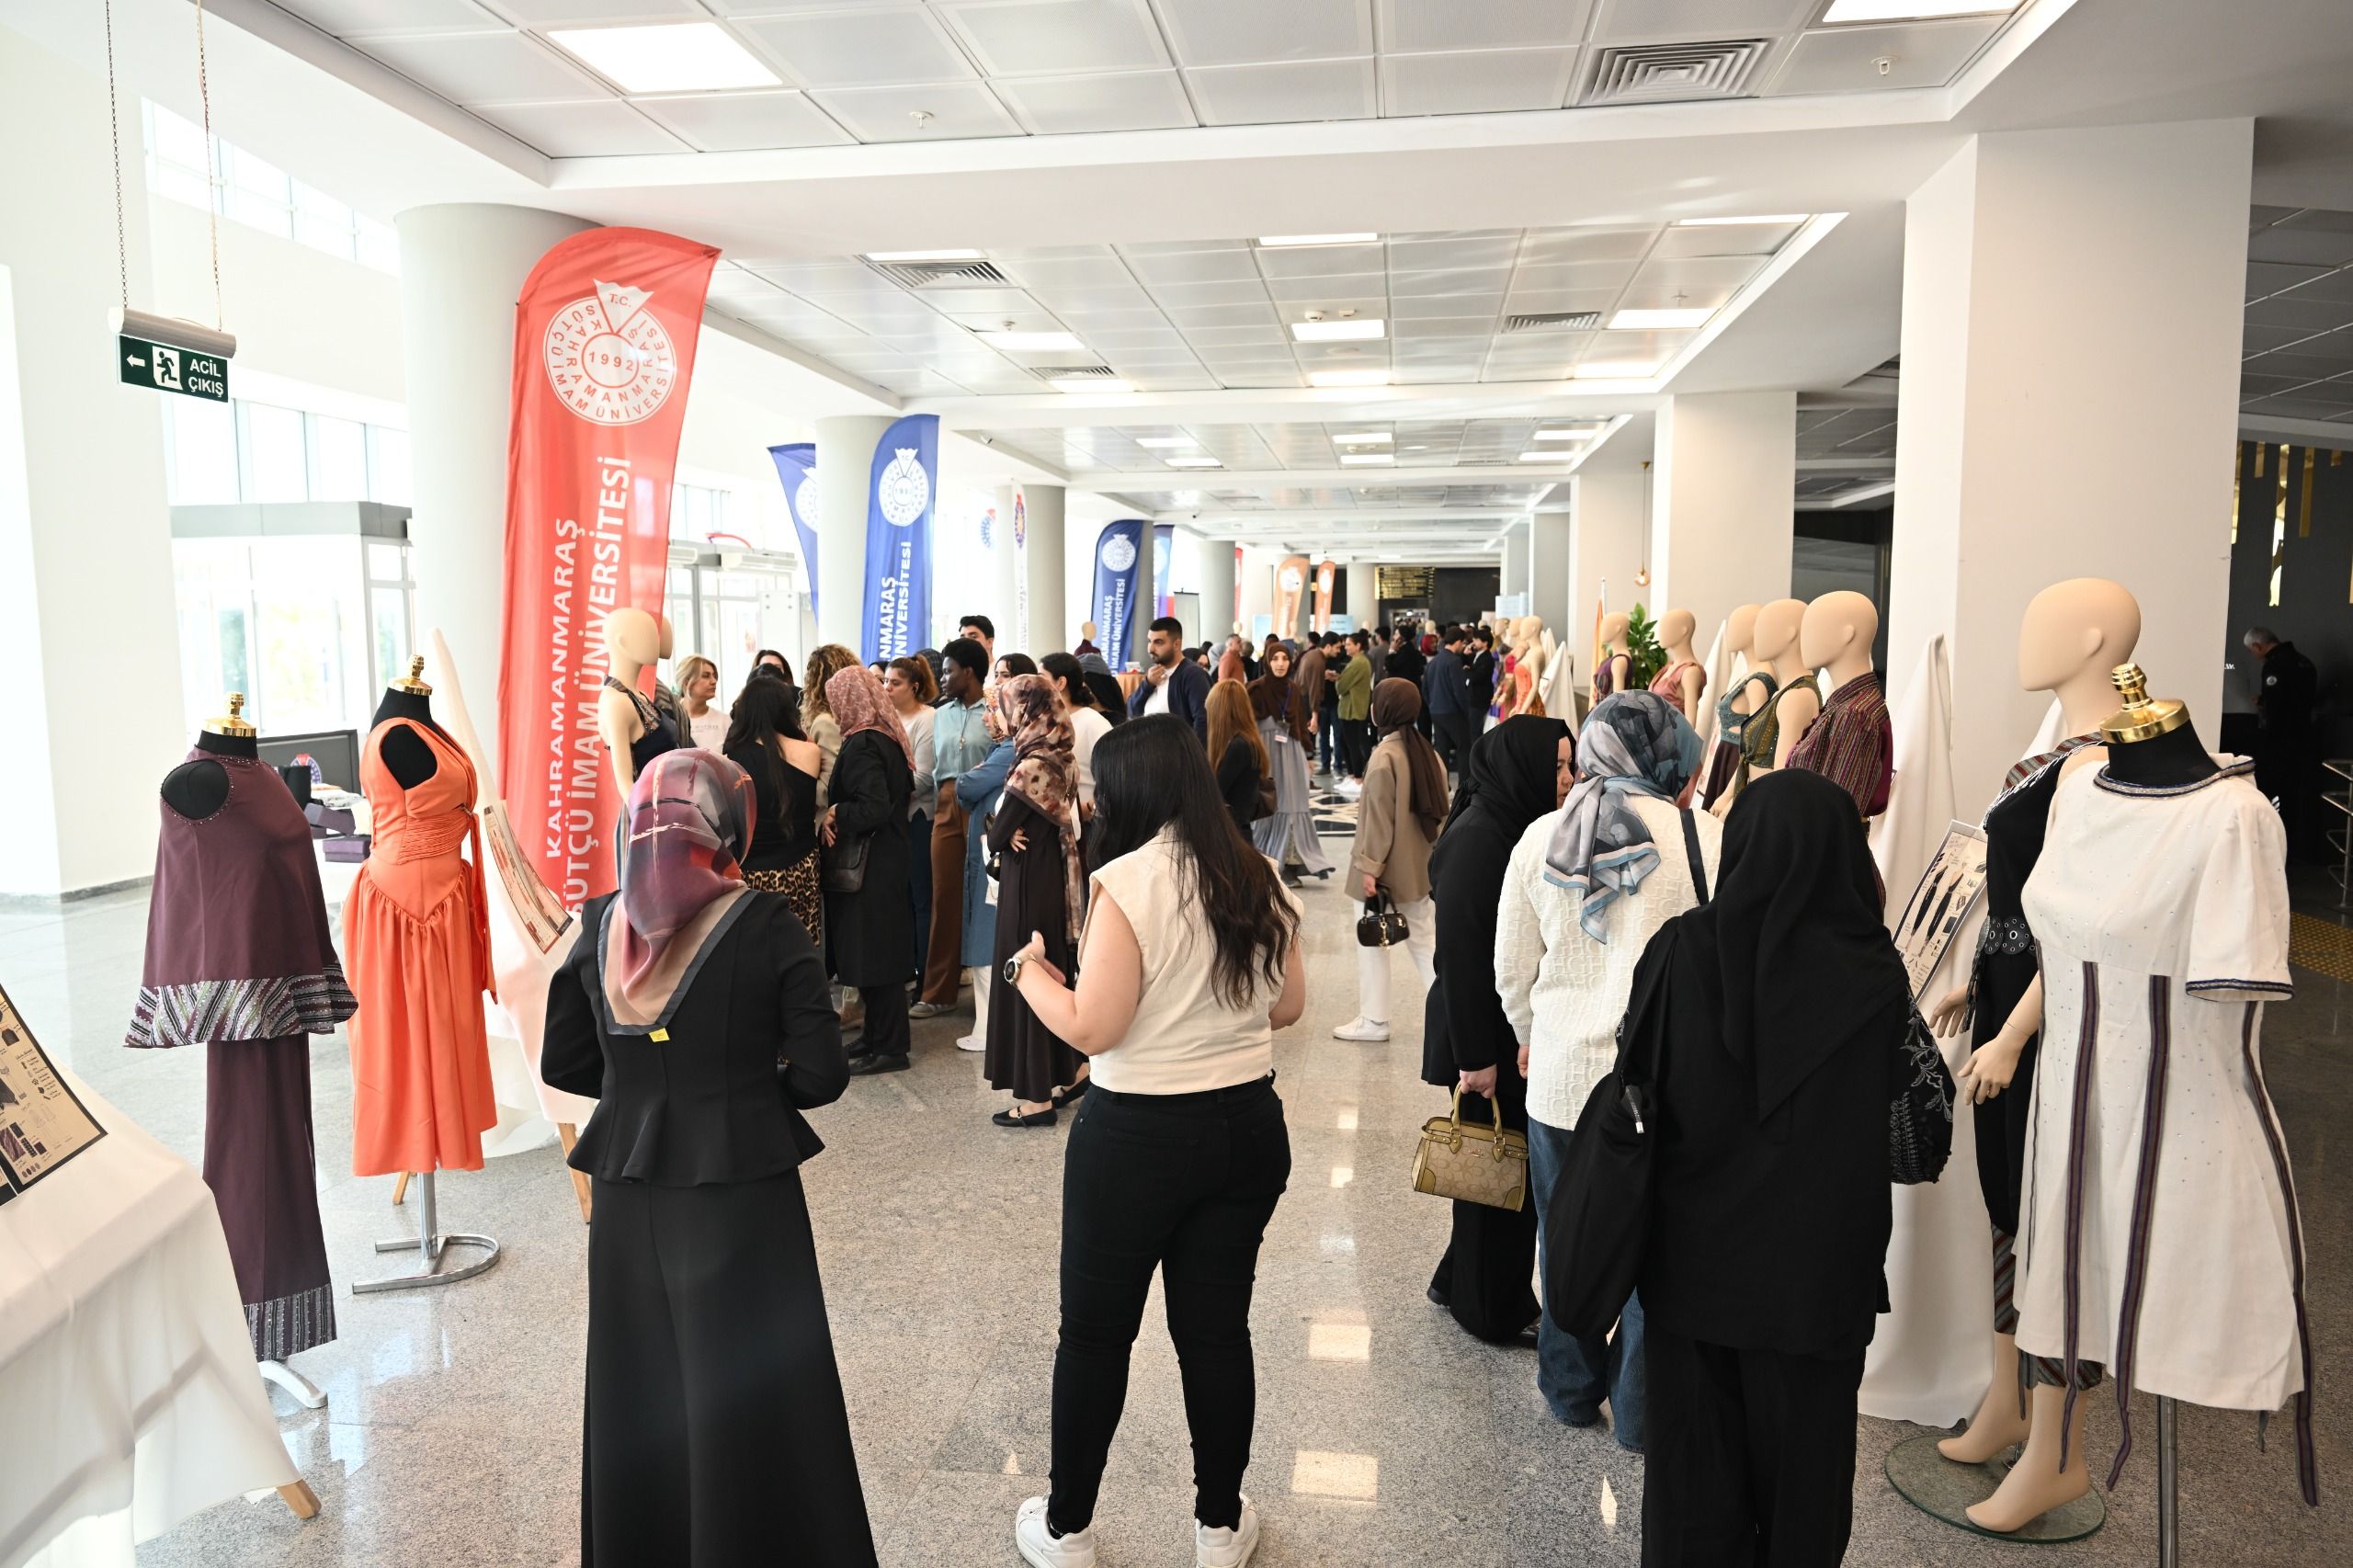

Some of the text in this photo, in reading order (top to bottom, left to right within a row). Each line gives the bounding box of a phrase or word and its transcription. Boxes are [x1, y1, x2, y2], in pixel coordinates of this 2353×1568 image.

[609, 293, 631, 308] T.C.
[188, 376, 224, 398] ÇIKIŞ
[189, 358, 222, 378] ACİL
[588, 351, 634, 371] 1992
[573, 456, 632, 691] ÜNİVERSİTESİ
[880, 576, 899, 662] NMARAŞ
[546, 517, 585, 858] KAHRAMANMARAŞ
[565, 701, 601, 799] İMAM
